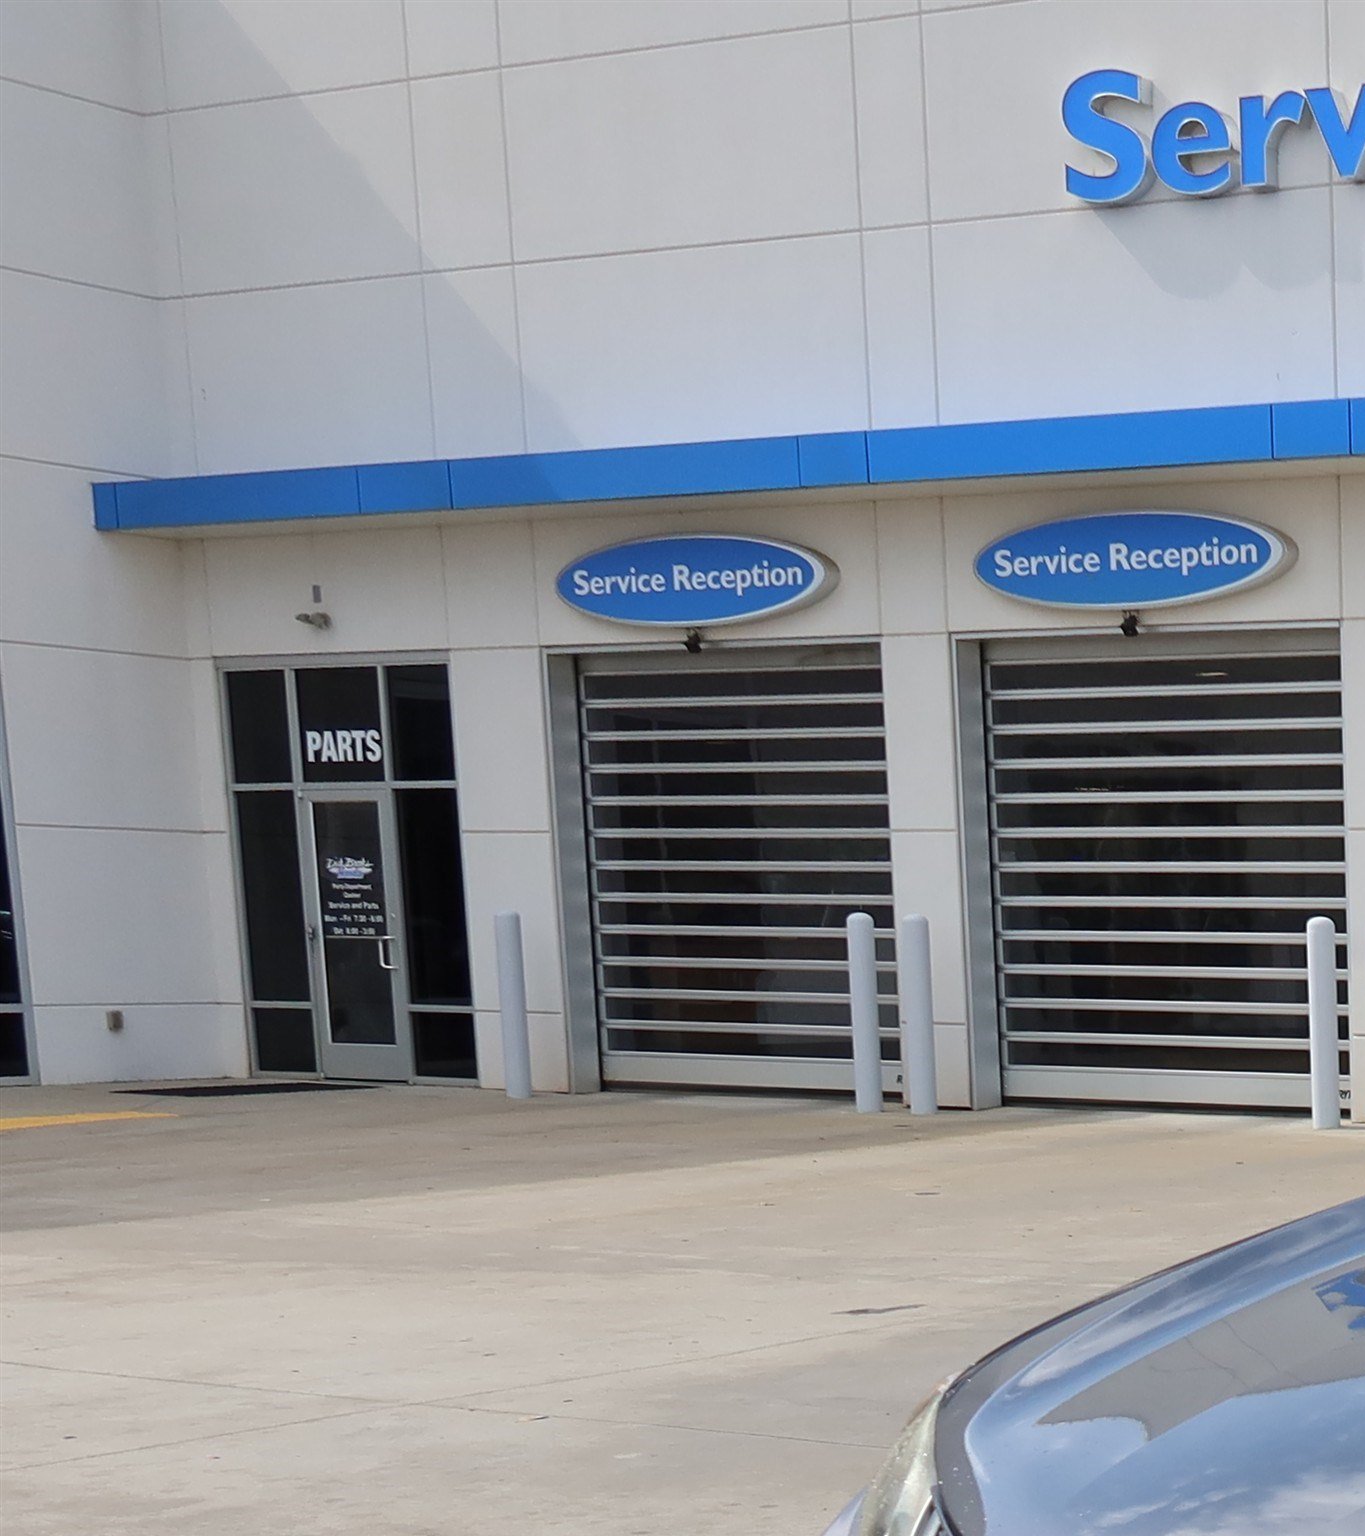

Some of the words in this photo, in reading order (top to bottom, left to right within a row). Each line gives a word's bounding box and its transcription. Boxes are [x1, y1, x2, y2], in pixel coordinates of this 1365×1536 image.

[994, 545, 1101, 577] Service
[1108, 536, 1258, 576] Reception
[572, 567, 666, 596] Service
[671, 560, 803, 597] Reception
[305, 729, 382, 763] PARTS
